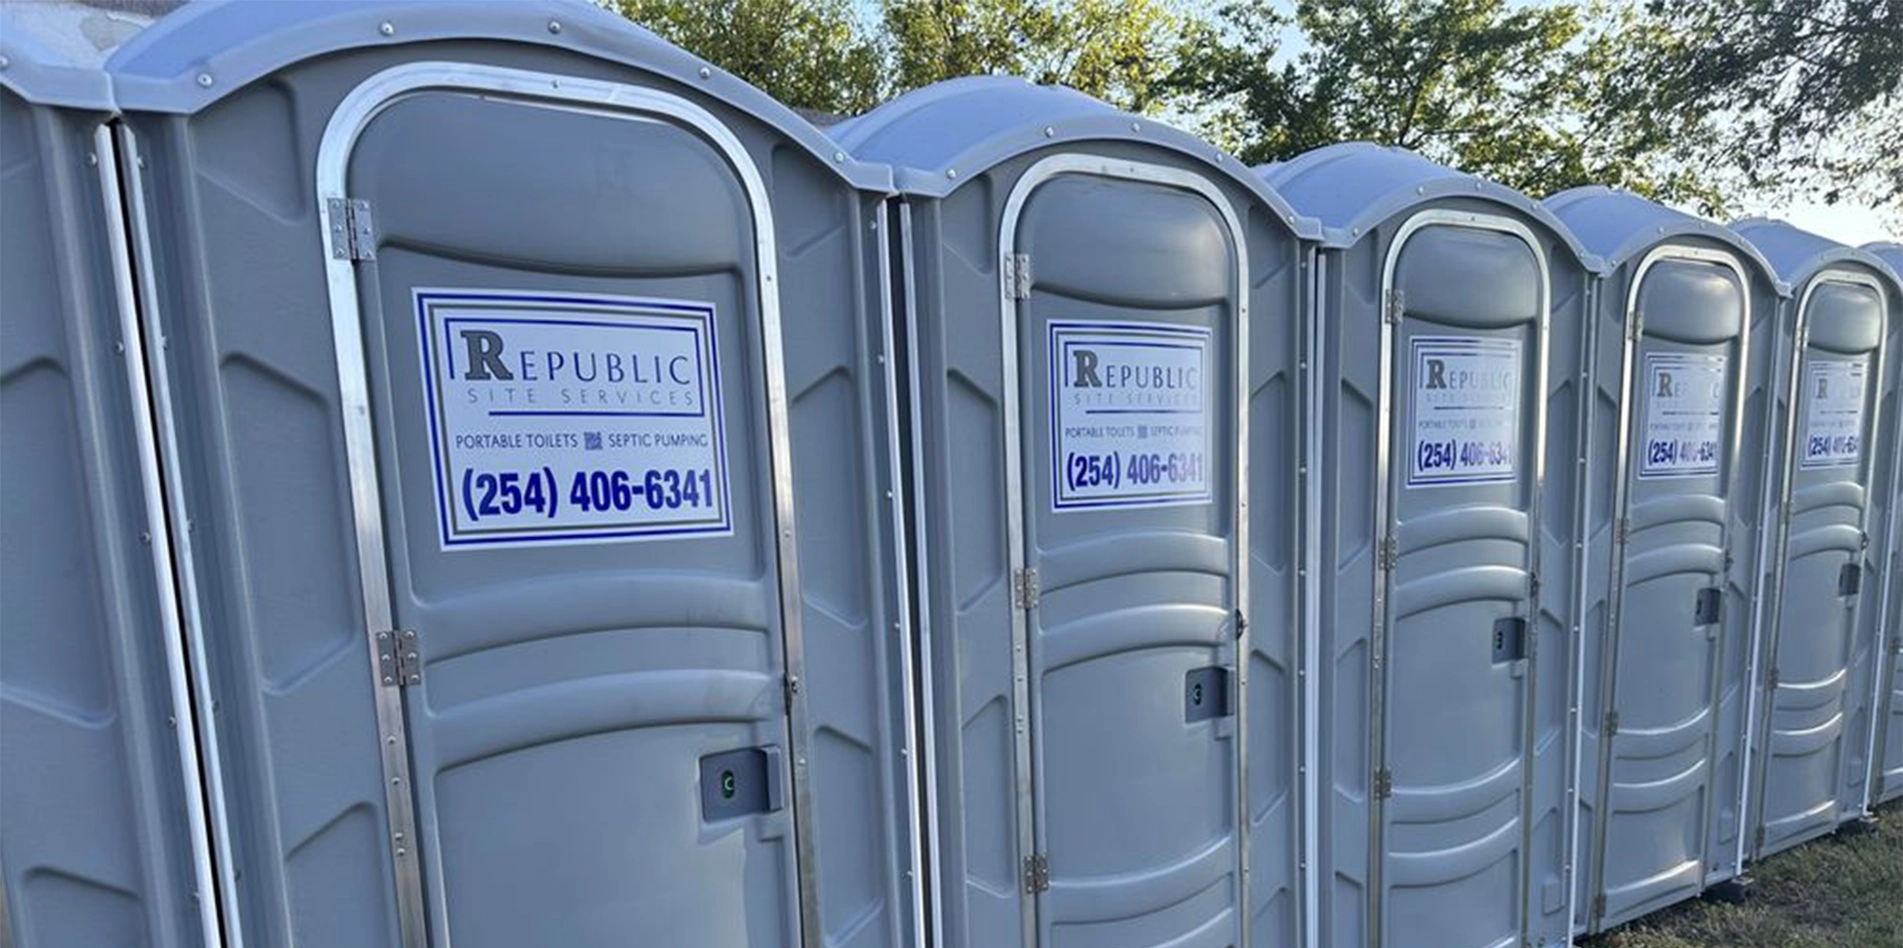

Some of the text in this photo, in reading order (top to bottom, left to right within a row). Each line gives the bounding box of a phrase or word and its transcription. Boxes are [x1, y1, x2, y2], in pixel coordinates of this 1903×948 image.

[467, 388, 693, 406] SITE SERVICES
[456, 434, 578, 449] PORTABLE TOILETS
[608, 433, 709, 448] SEPTIC PUMPING
[1065, 425, 1104, 438] PORTABLE
[1417, 438, 1457, 472] (254)
[1648, 439, 1678, 466] (254)
[1067, 451, 1203, 491] (254) 406-6341
[462, 466, 713, 521] (254) 406-6341
